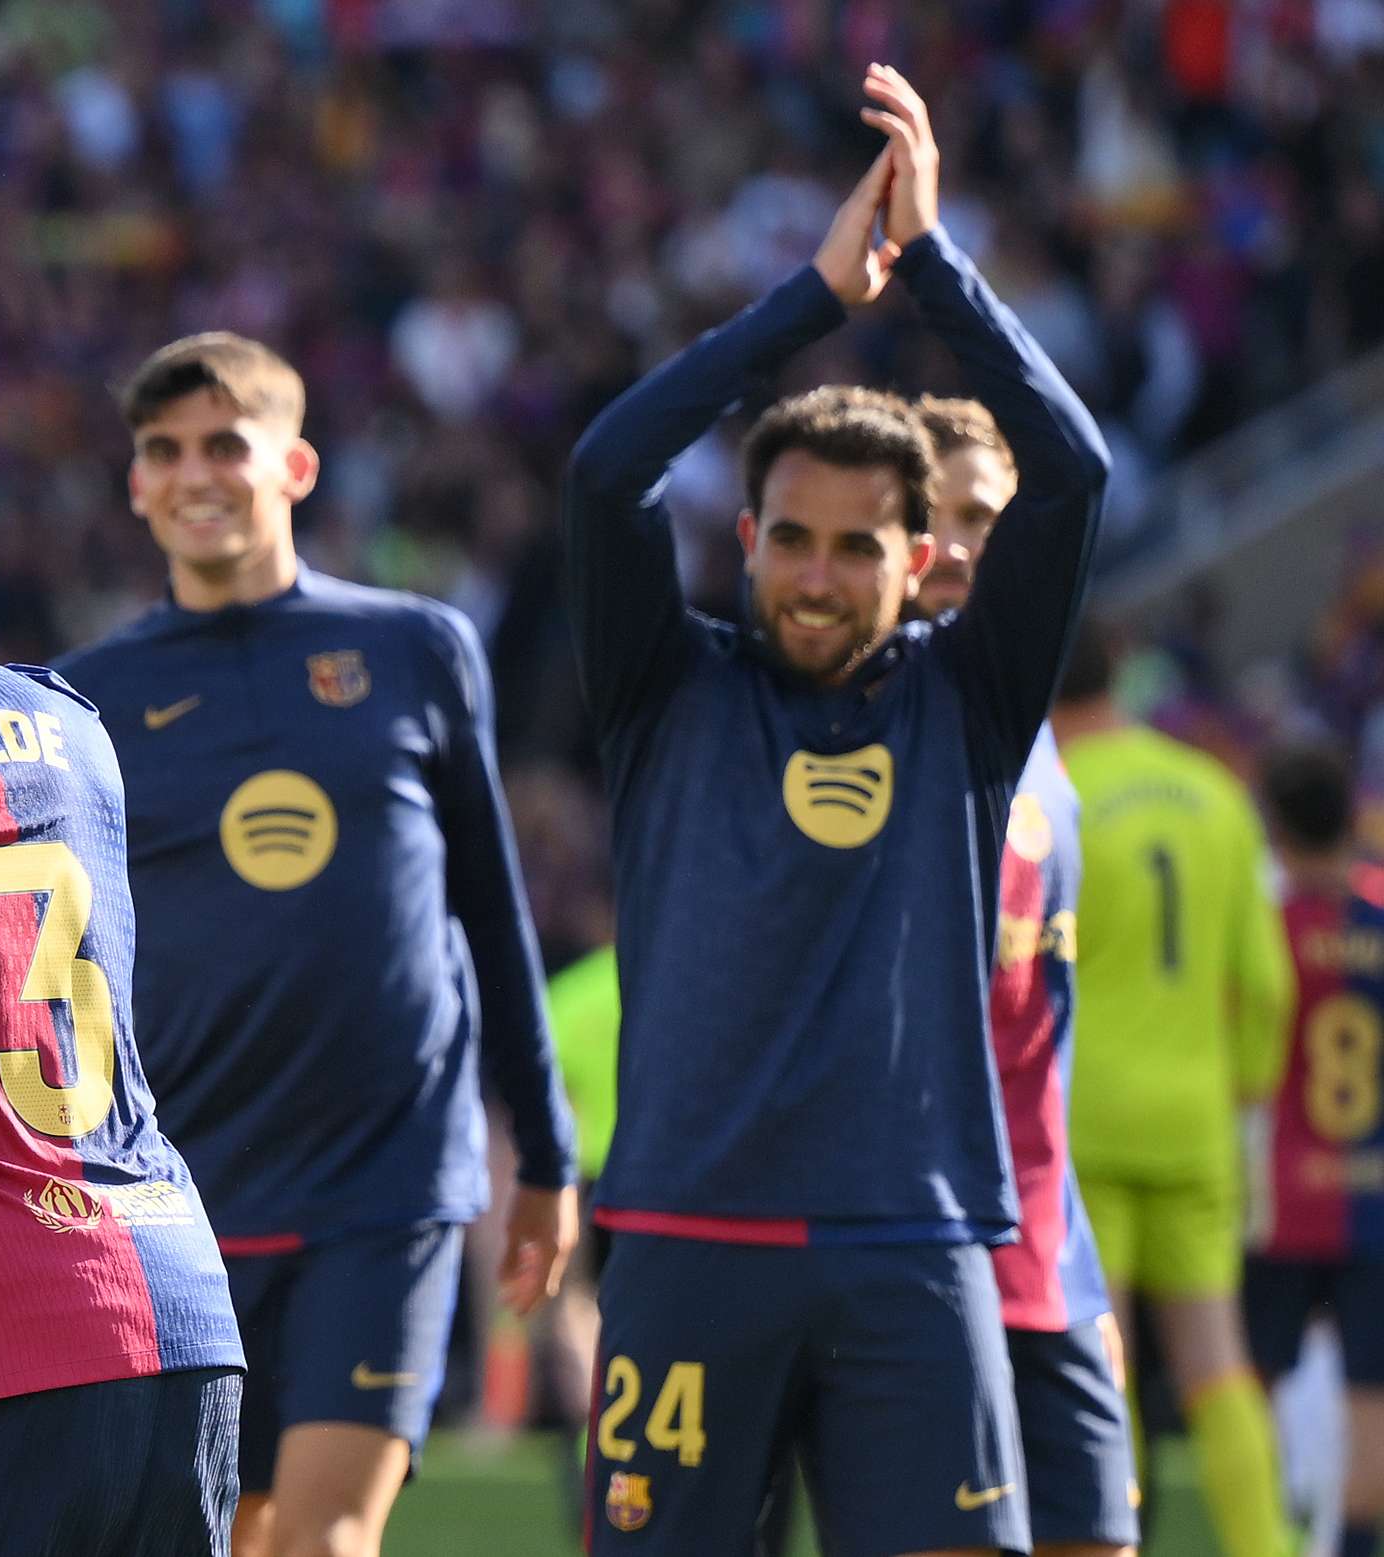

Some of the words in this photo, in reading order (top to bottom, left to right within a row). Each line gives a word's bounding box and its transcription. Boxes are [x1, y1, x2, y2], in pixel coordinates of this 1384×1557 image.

[1149, 846, 1181, 976] 1
[1304, 991, 1381, 1143] 8
[597, 1355, 707, 1467] 24
